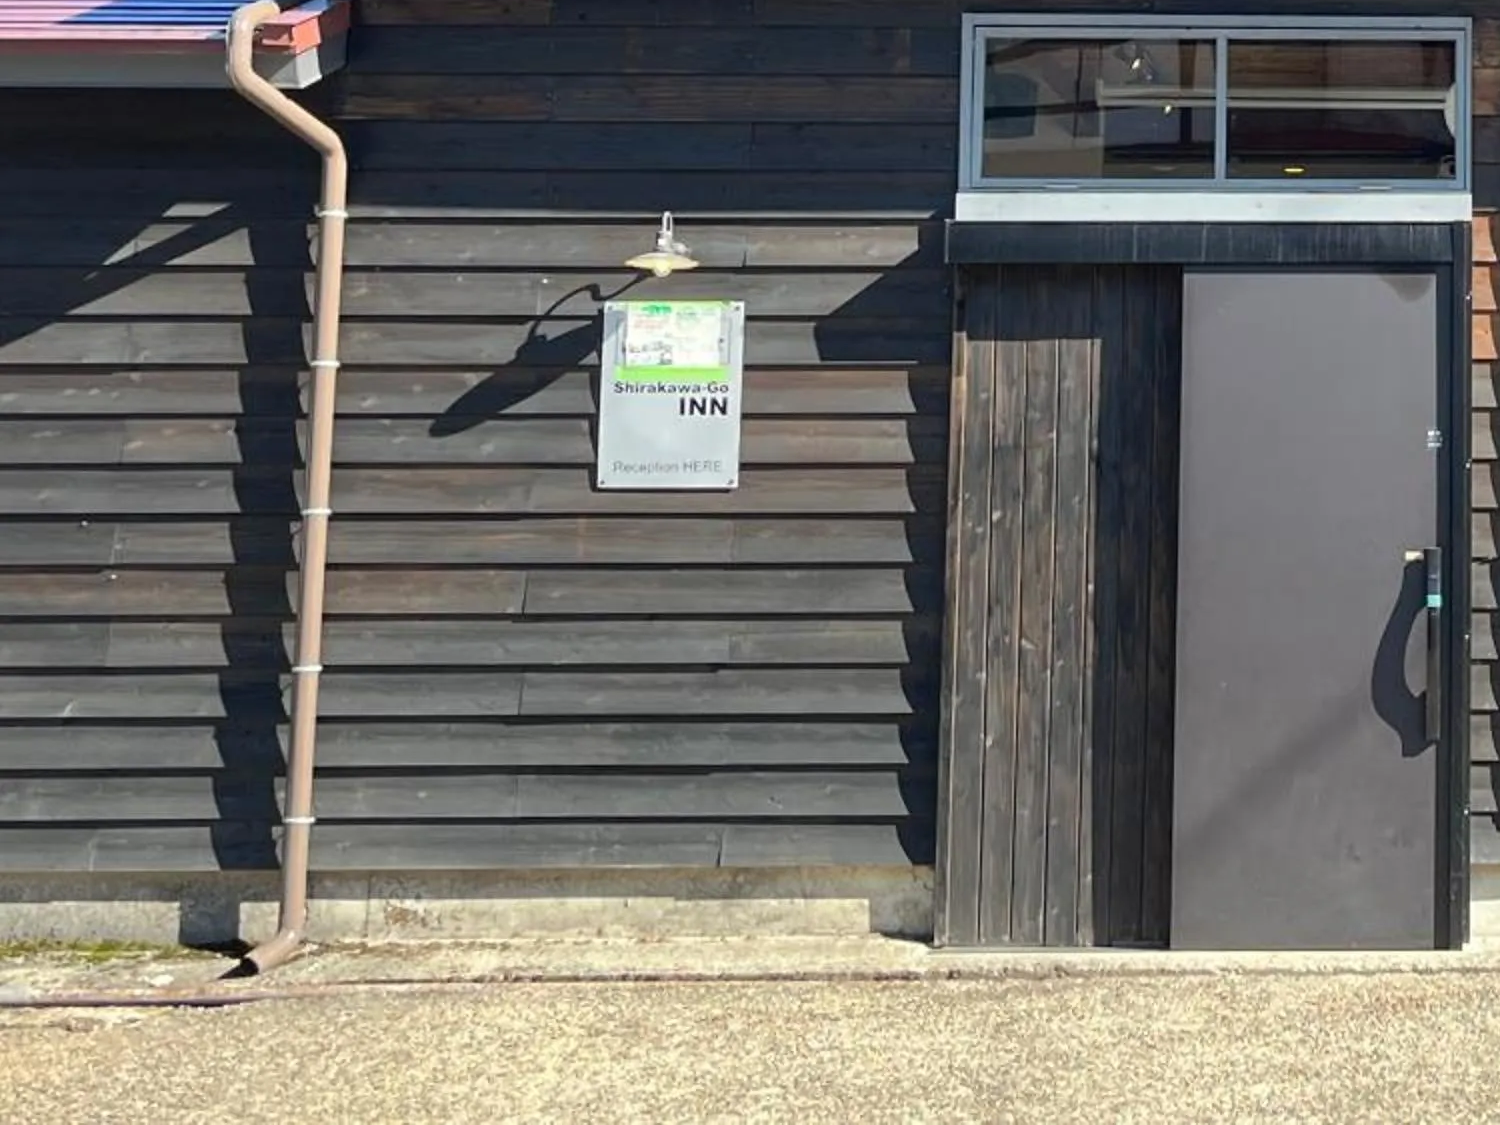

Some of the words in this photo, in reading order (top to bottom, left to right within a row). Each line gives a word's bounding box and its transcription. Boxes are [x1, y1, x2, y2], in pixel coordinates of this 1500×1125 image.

[613, 381, 729, 394] Shirakawa-Go
[679, 397, 729, 416] INN
[612, 460, 679, 474] Reception
[682, 460, 722, 473] HERE
